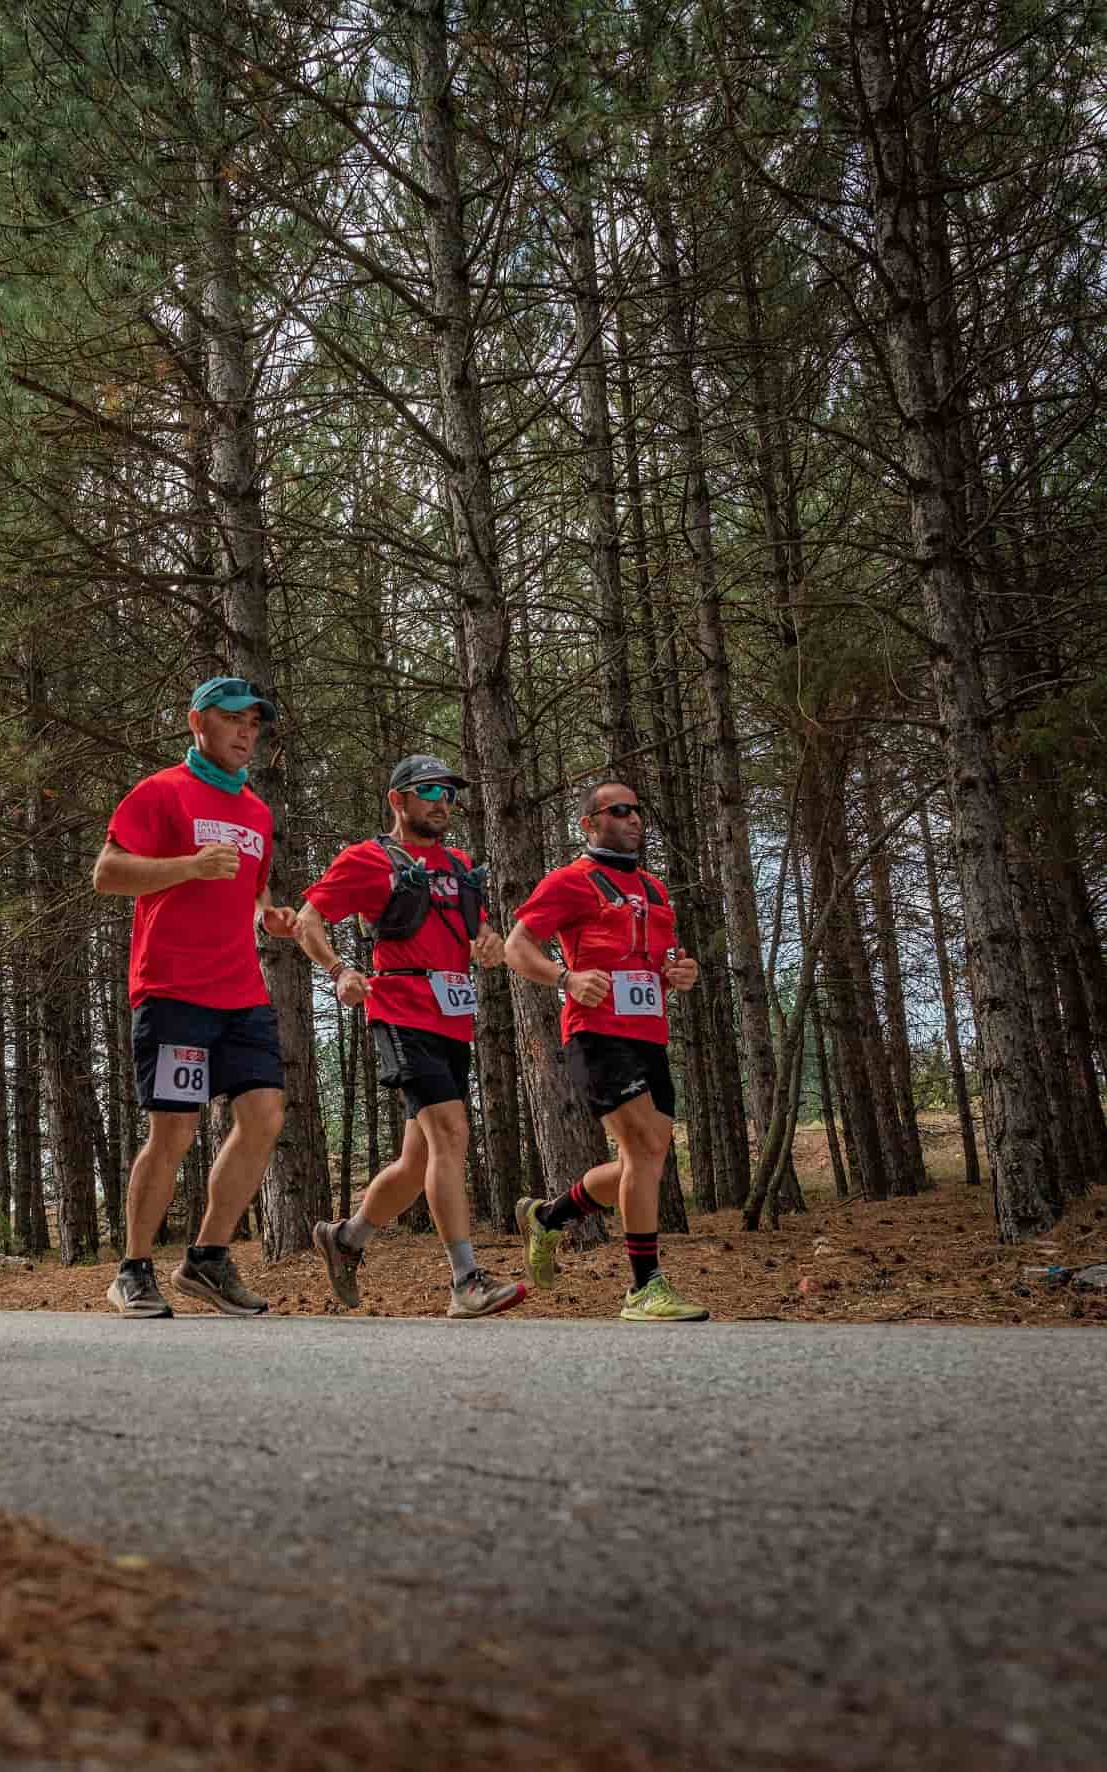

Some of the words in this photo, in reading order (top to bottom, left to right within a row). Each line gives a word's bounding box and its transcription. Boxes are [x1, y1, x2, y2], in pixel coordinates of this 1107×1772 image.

[447, 988, 477, 1007] 02
[629, 986, 656, 1006] 06
[173, 1066, 204, 1091] 08
